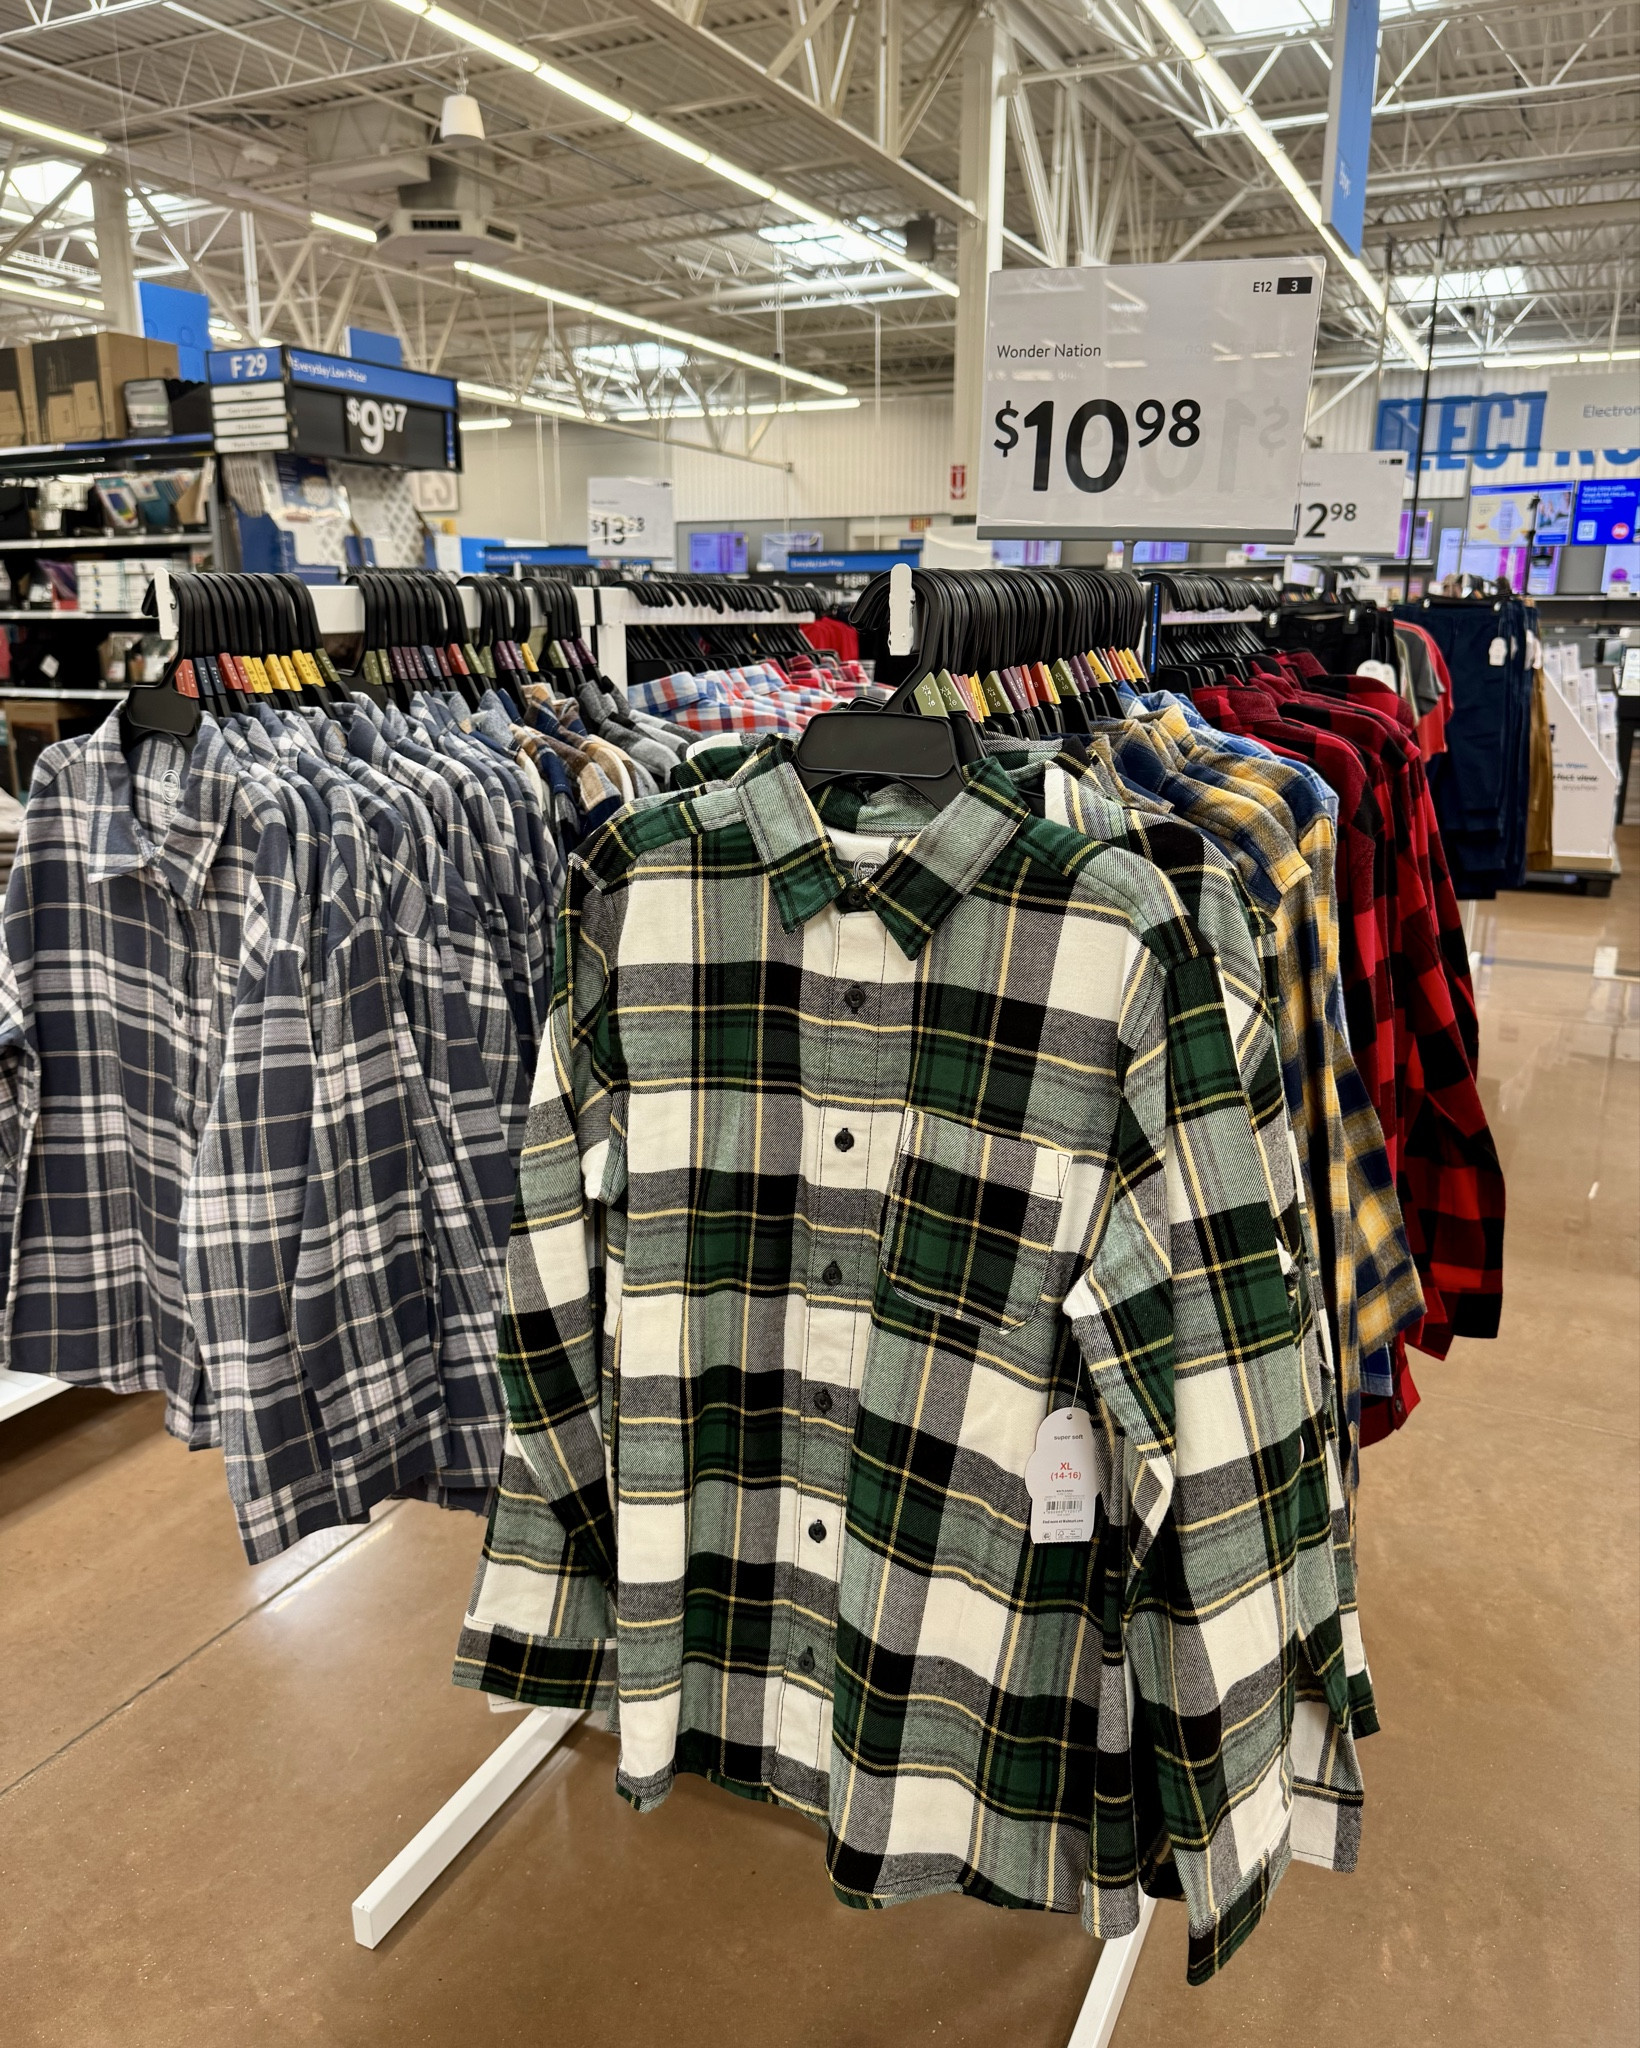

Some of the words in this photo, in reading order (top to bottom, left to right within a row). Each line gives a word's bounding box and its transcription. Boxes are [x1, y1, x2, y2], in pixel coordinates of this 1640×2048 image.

[1253, 281, 1272, 293] E12
[1290, 281, 1298, 292] 3
[997, 345, 1050, 359] Wonder
[1054, 344, 1101, 358] Nation
[230, 355, 243, 379] F
[244, 352, 268, 378] 29
[1060, 1462, 1072, 1470] XL
[1050, 1472, 1082, 1481] (14-16)
